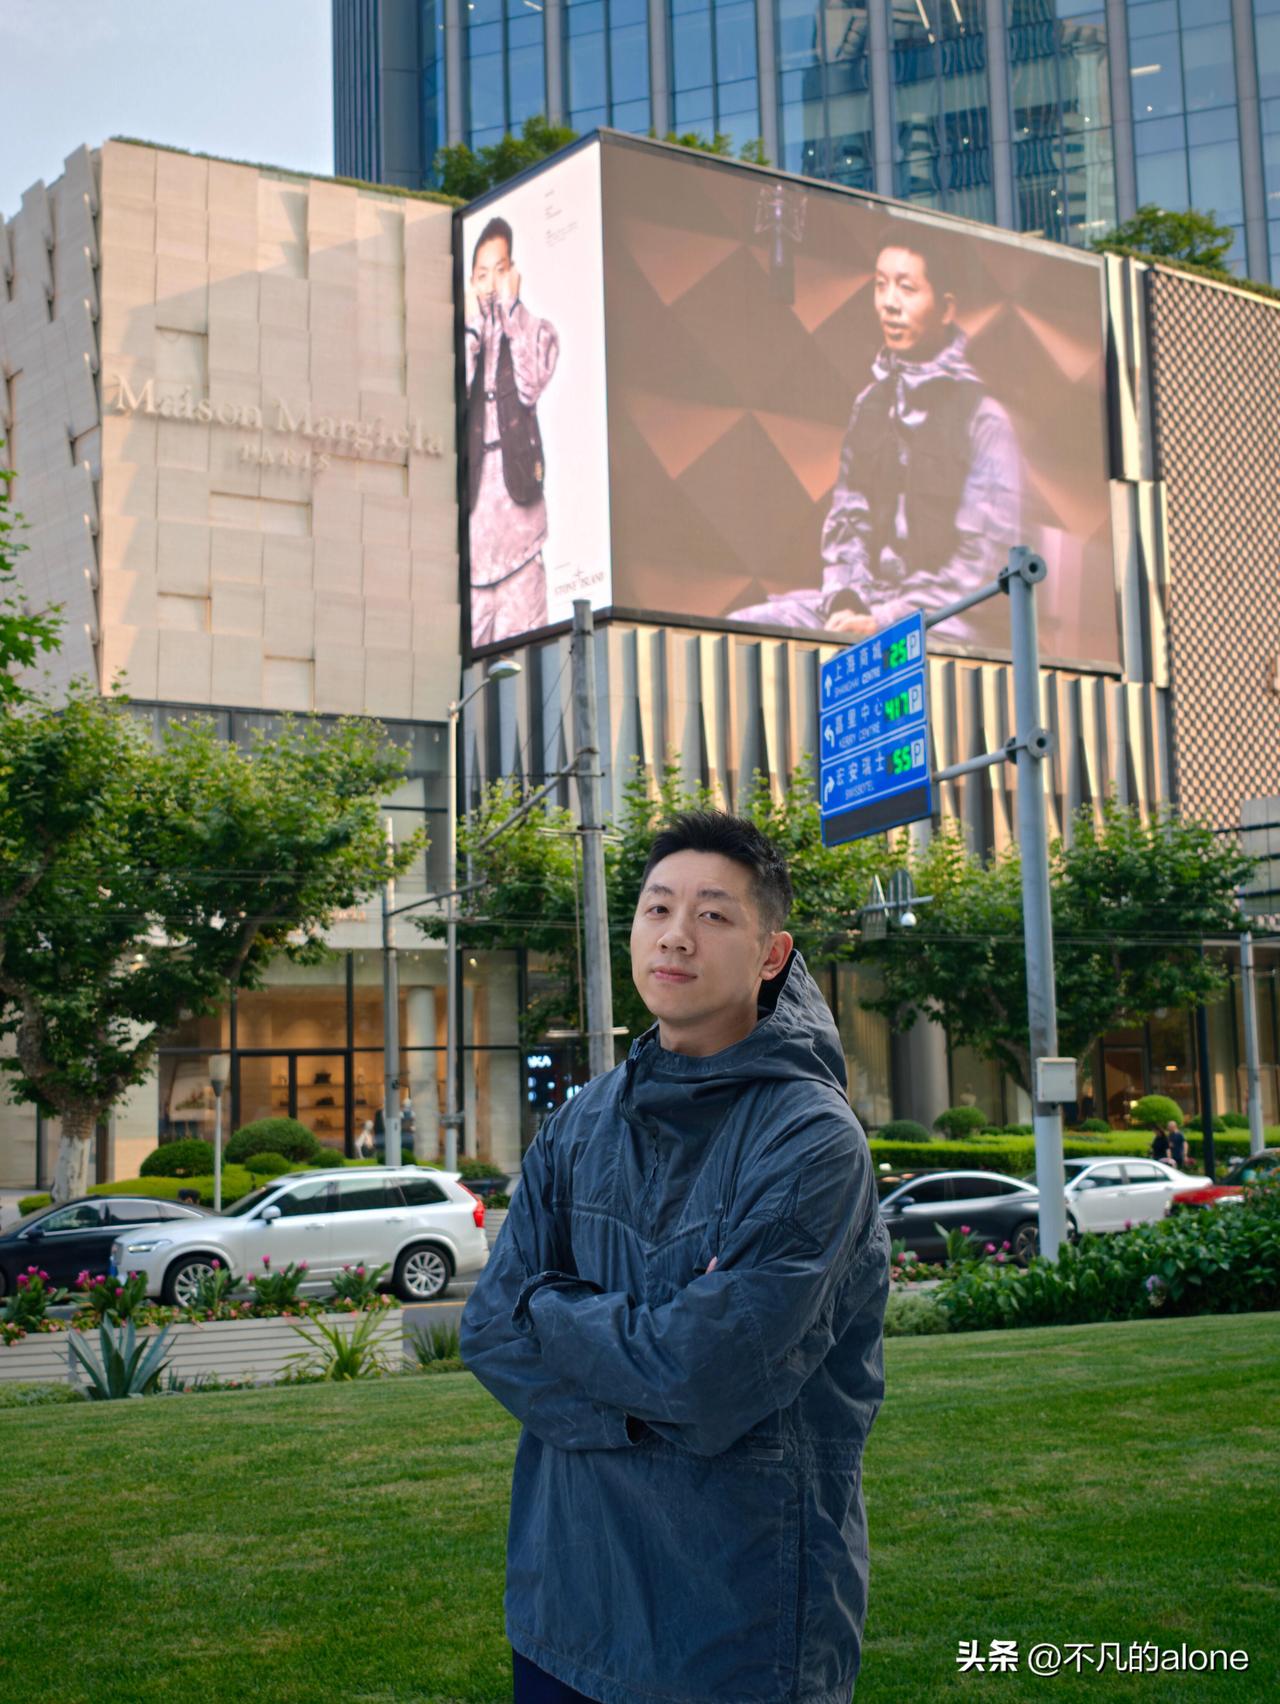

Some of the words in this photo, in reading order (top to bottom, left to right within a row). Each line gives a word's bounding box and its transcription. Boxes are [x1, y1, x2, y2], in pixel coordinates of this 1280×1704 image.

[117, 375, 263, 430] Maison
[276, 397, 443, 456] Margiela
[241, 442, 331, 472] PARIS
[835, 640, 882, 681] 上海商城
[889, 637, 908, 670] 25
[892, 744, 913, 774] 55
